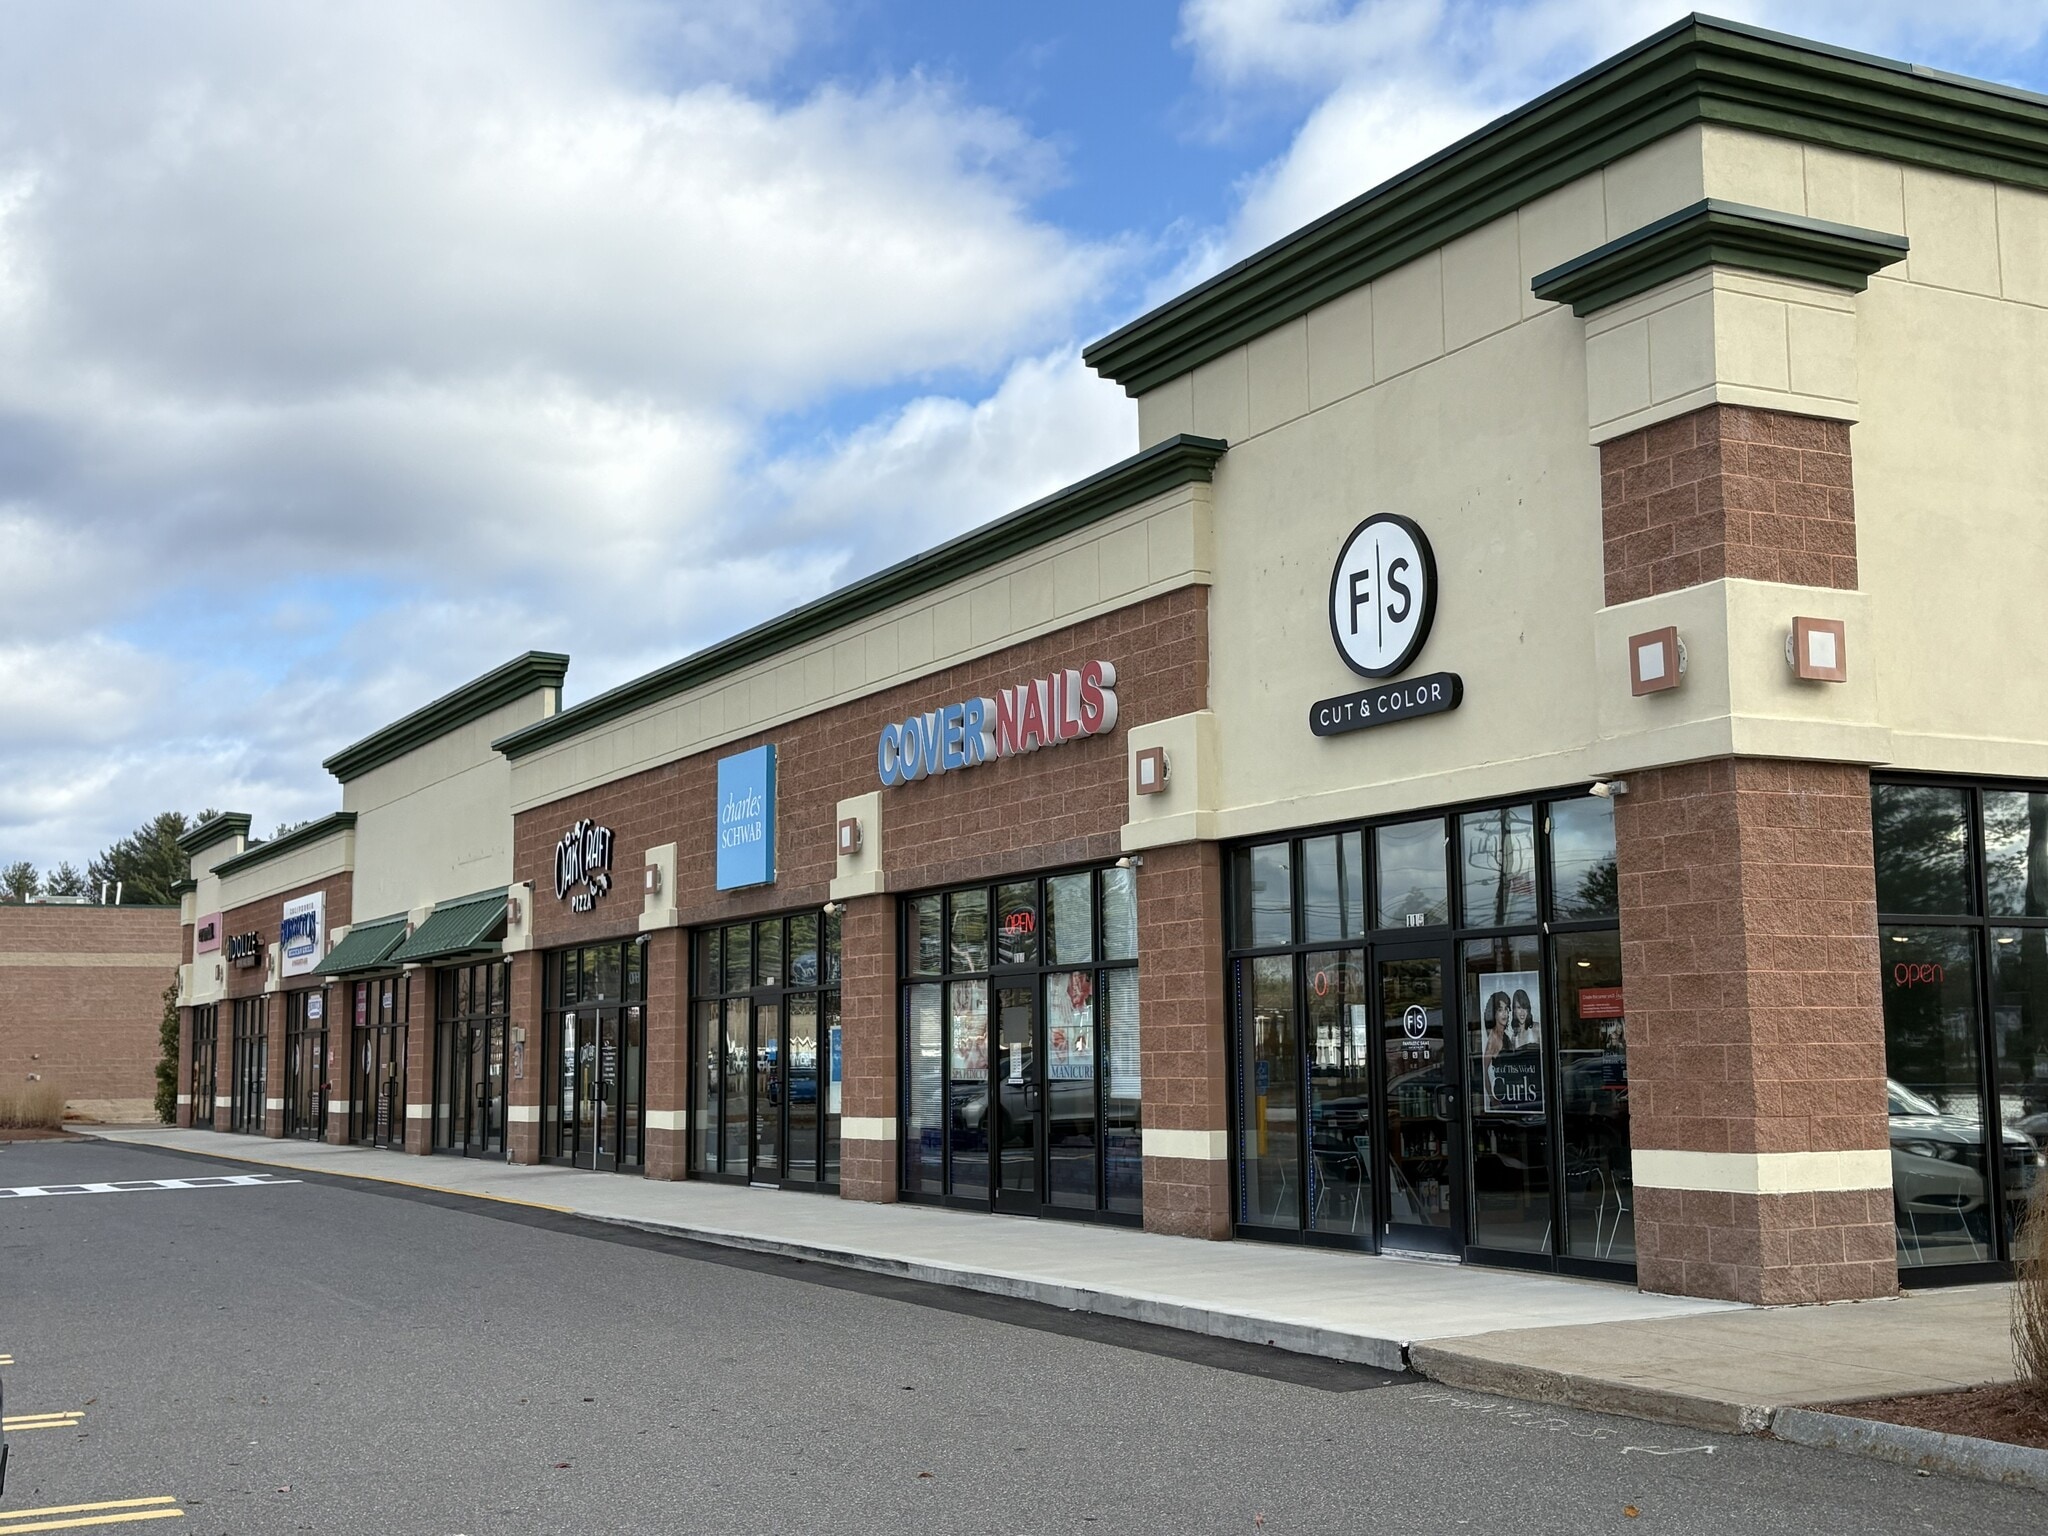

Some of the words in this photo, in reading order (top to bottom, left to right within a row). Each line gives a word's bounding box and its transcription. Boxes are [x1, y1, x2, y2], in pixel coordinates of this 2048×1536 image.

[1320, 703, 1354, 727] CUT
[1360, 700, 1371, 718] &
[1377, 683, 1442, 714] COLOR
[878, 696, 990, 786] COVER
[996, 660, 1110, 758] NAILS
[722, 786, 762, 825] charles
[721, 821, 762, 849] SCHWAB
[571, 893, 592, 913] PIZZA
[1005, 912, 1035, 935] OPEN
[1894, 962, 1944, 989] open
[1491, 1075, 1537, 1102] Curls
